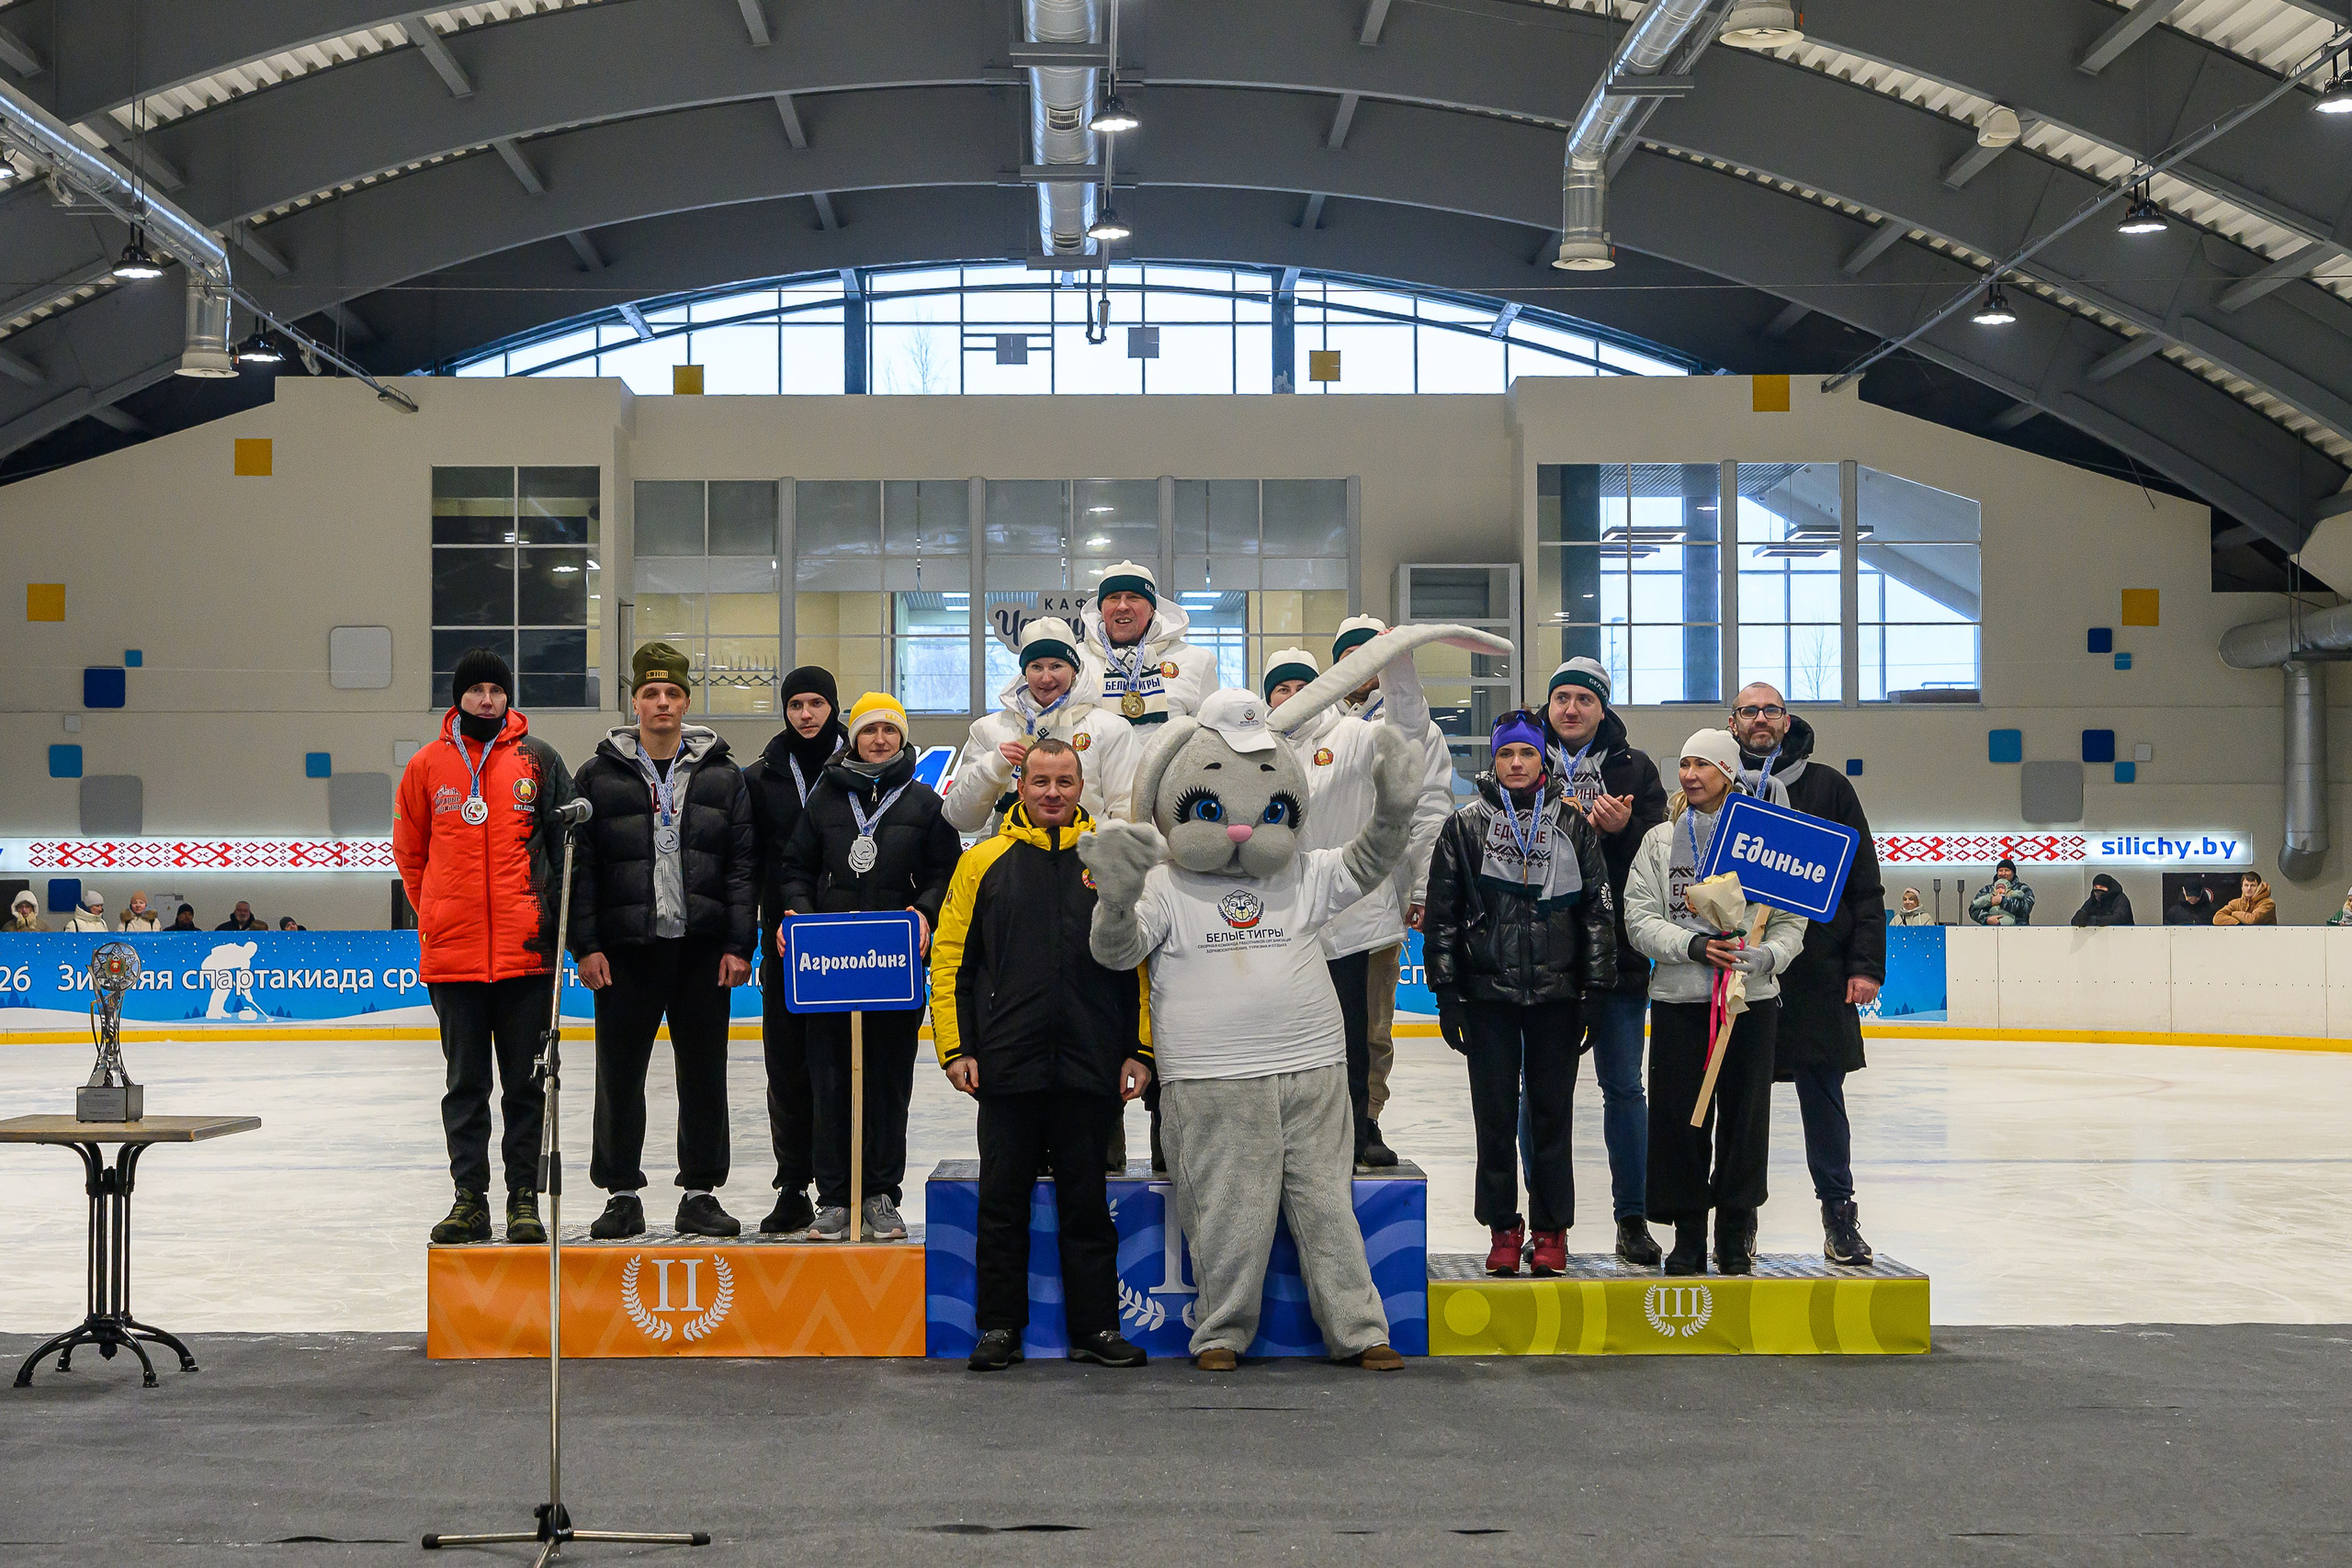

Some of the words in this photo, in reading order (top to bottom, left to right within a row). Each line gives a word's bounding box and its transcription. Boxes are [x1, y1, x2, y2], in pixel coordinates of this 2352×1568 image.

[1044, 598, 1086, 610] КАФ
[1105, 680, 1127, 691] БЕЛ
[1138, 677, 1160, 691] ИГРЫ
[1731, 832, 1826, 883] Единые
[2101, 837, 2237, 859] silichy.by
[1206, 931, 1245, 942] БЕЛЫЕ
[1247, 928, 1283, 939] ТИГРЫ
[798, 949, 906, 976] Агрохолдинг
[0, 964, 32, 992] 26
[57, 964, 173, 991] Зияя
[181, 968, 374, 996] спартакиада
[651, 1258, 705, 1312] II
[1656, 1287, 1702, 1317] III
